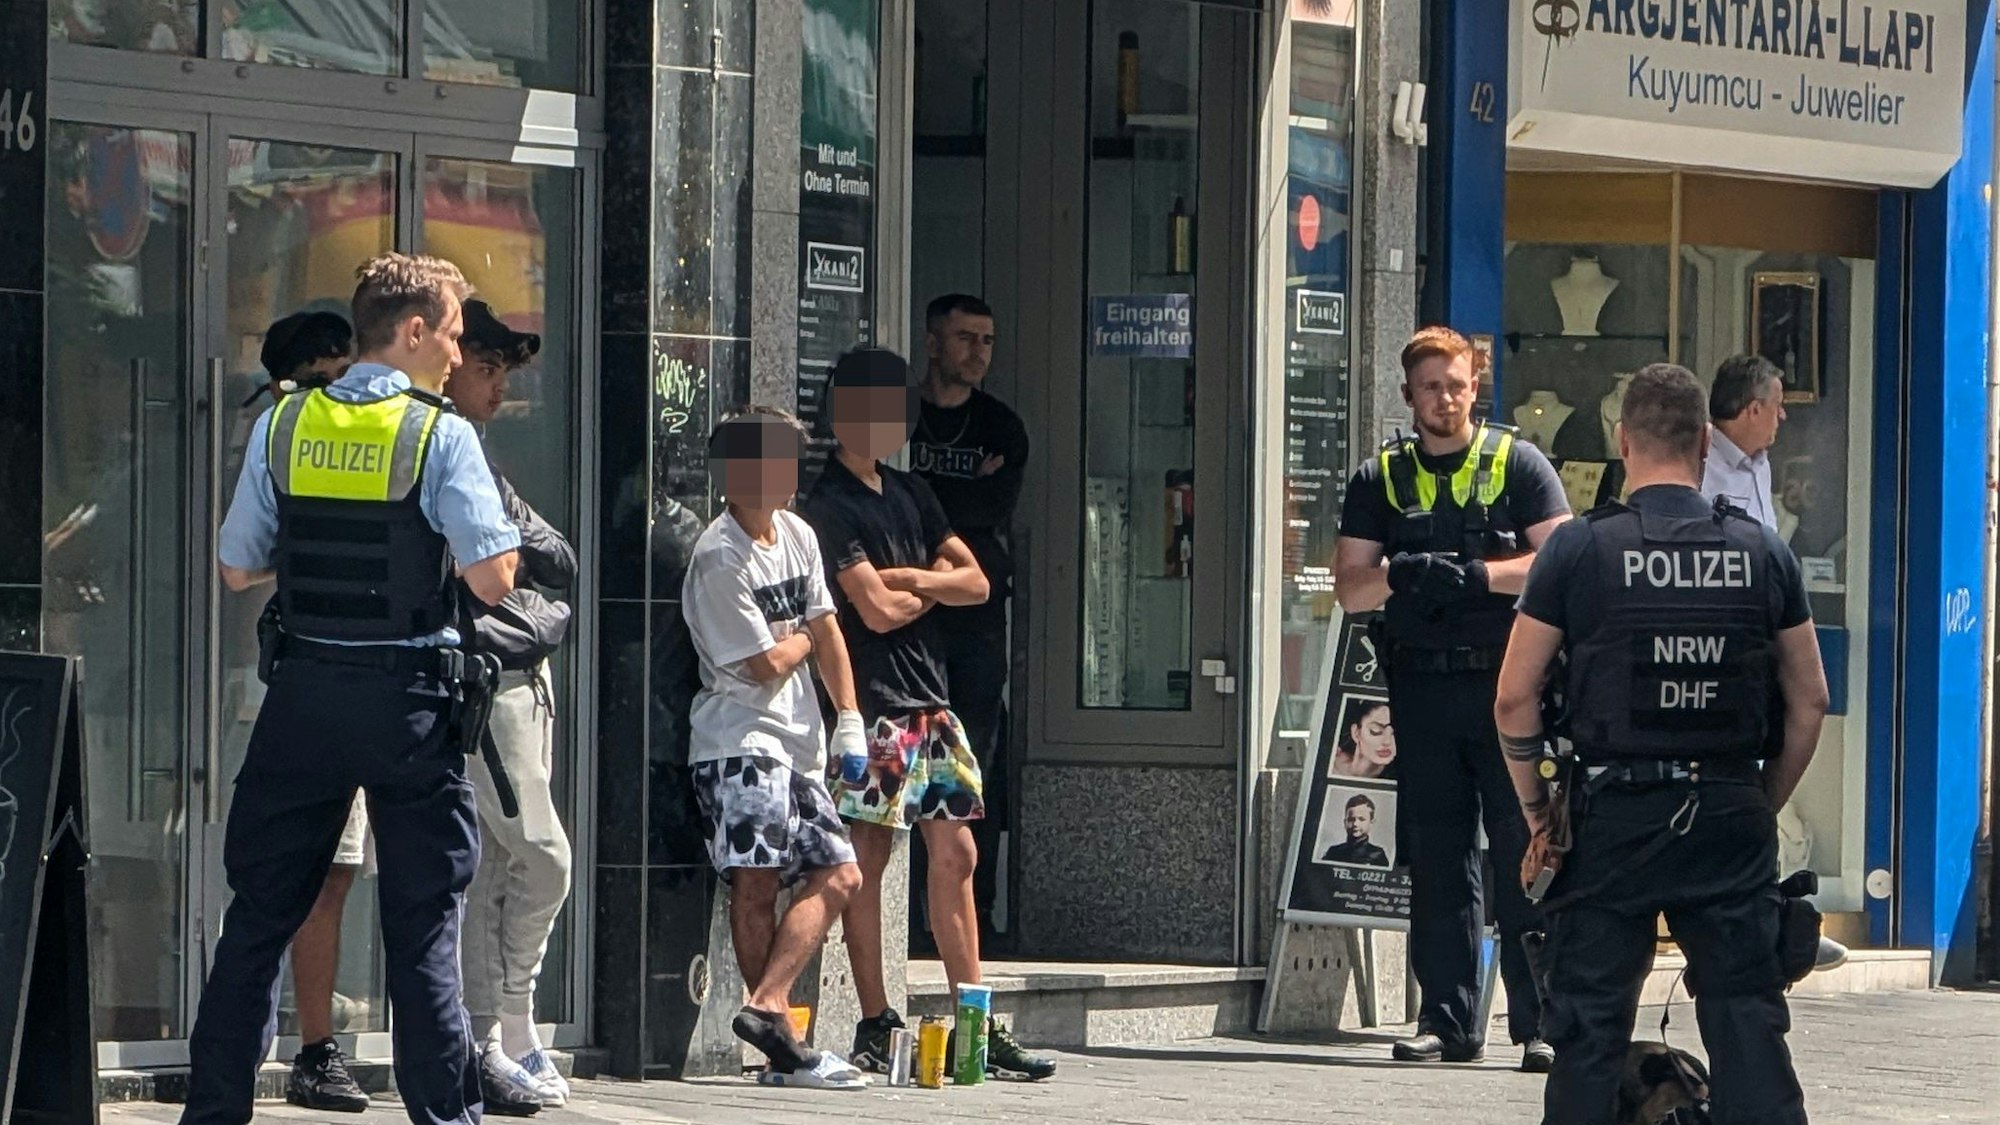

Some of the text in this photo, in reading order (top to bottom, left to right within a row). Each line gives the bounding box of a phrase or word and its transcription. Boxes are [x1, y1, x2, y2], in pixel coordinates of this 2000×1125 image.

[1470, 81, 1495, 122] 42
[1628, 54, 1763, 113] Kuyumcu
[1791, 73, 1905, 125] Juwelier
[0, 87, 36, 152] 46
[818, 142, 857, 168] Mit und
[804, 170, 870, 197] Ohne Termin
[1106, 302, 1190, 326] Eingang
[1094, 325, 1193, 346] freihalten
[297, 438, 386, 473] POLIZEI
[1623, 550, 1752, 588] POLIZEI
[1653, 636, 1726, 664] NRW
[1659, 680, 1720, 709] DHF
